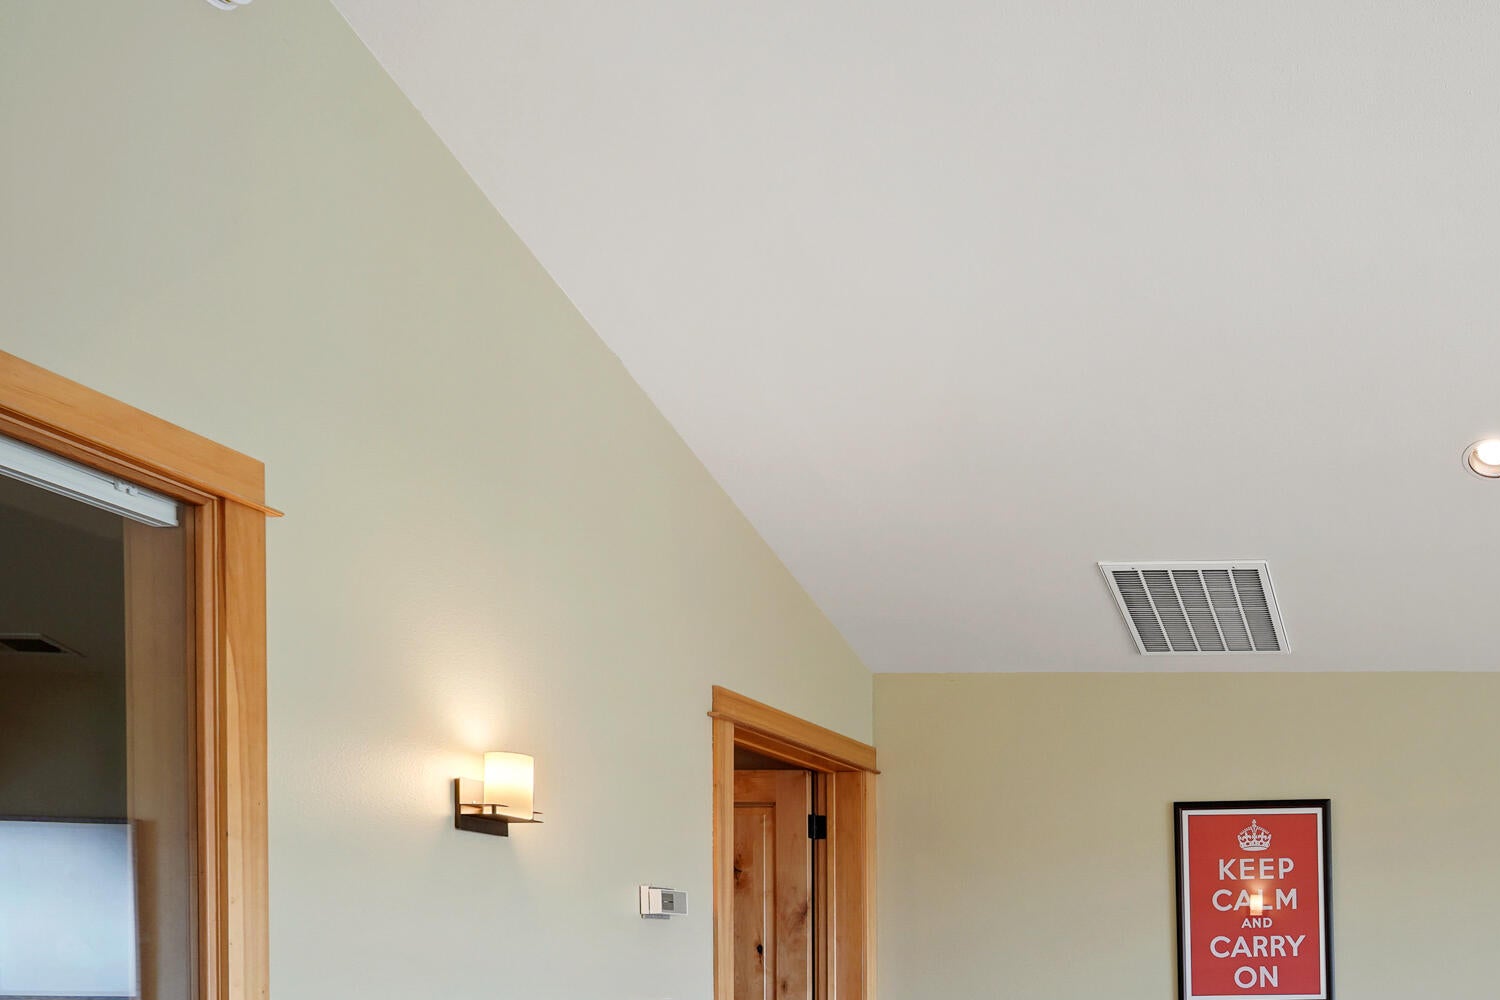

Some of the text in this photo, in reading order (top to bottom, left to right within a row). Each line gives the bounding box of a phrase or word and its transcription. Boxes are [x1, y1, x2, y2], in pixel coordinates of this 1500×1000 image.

[1218, 857, 1294, 880] KEEP
[1212, 888, 1297, 911] CALM
[1241, 917, 1273, 929] AND
[1210, 934, 1306, 958] CARRY
[1234, 965, 1279, 988] ON
